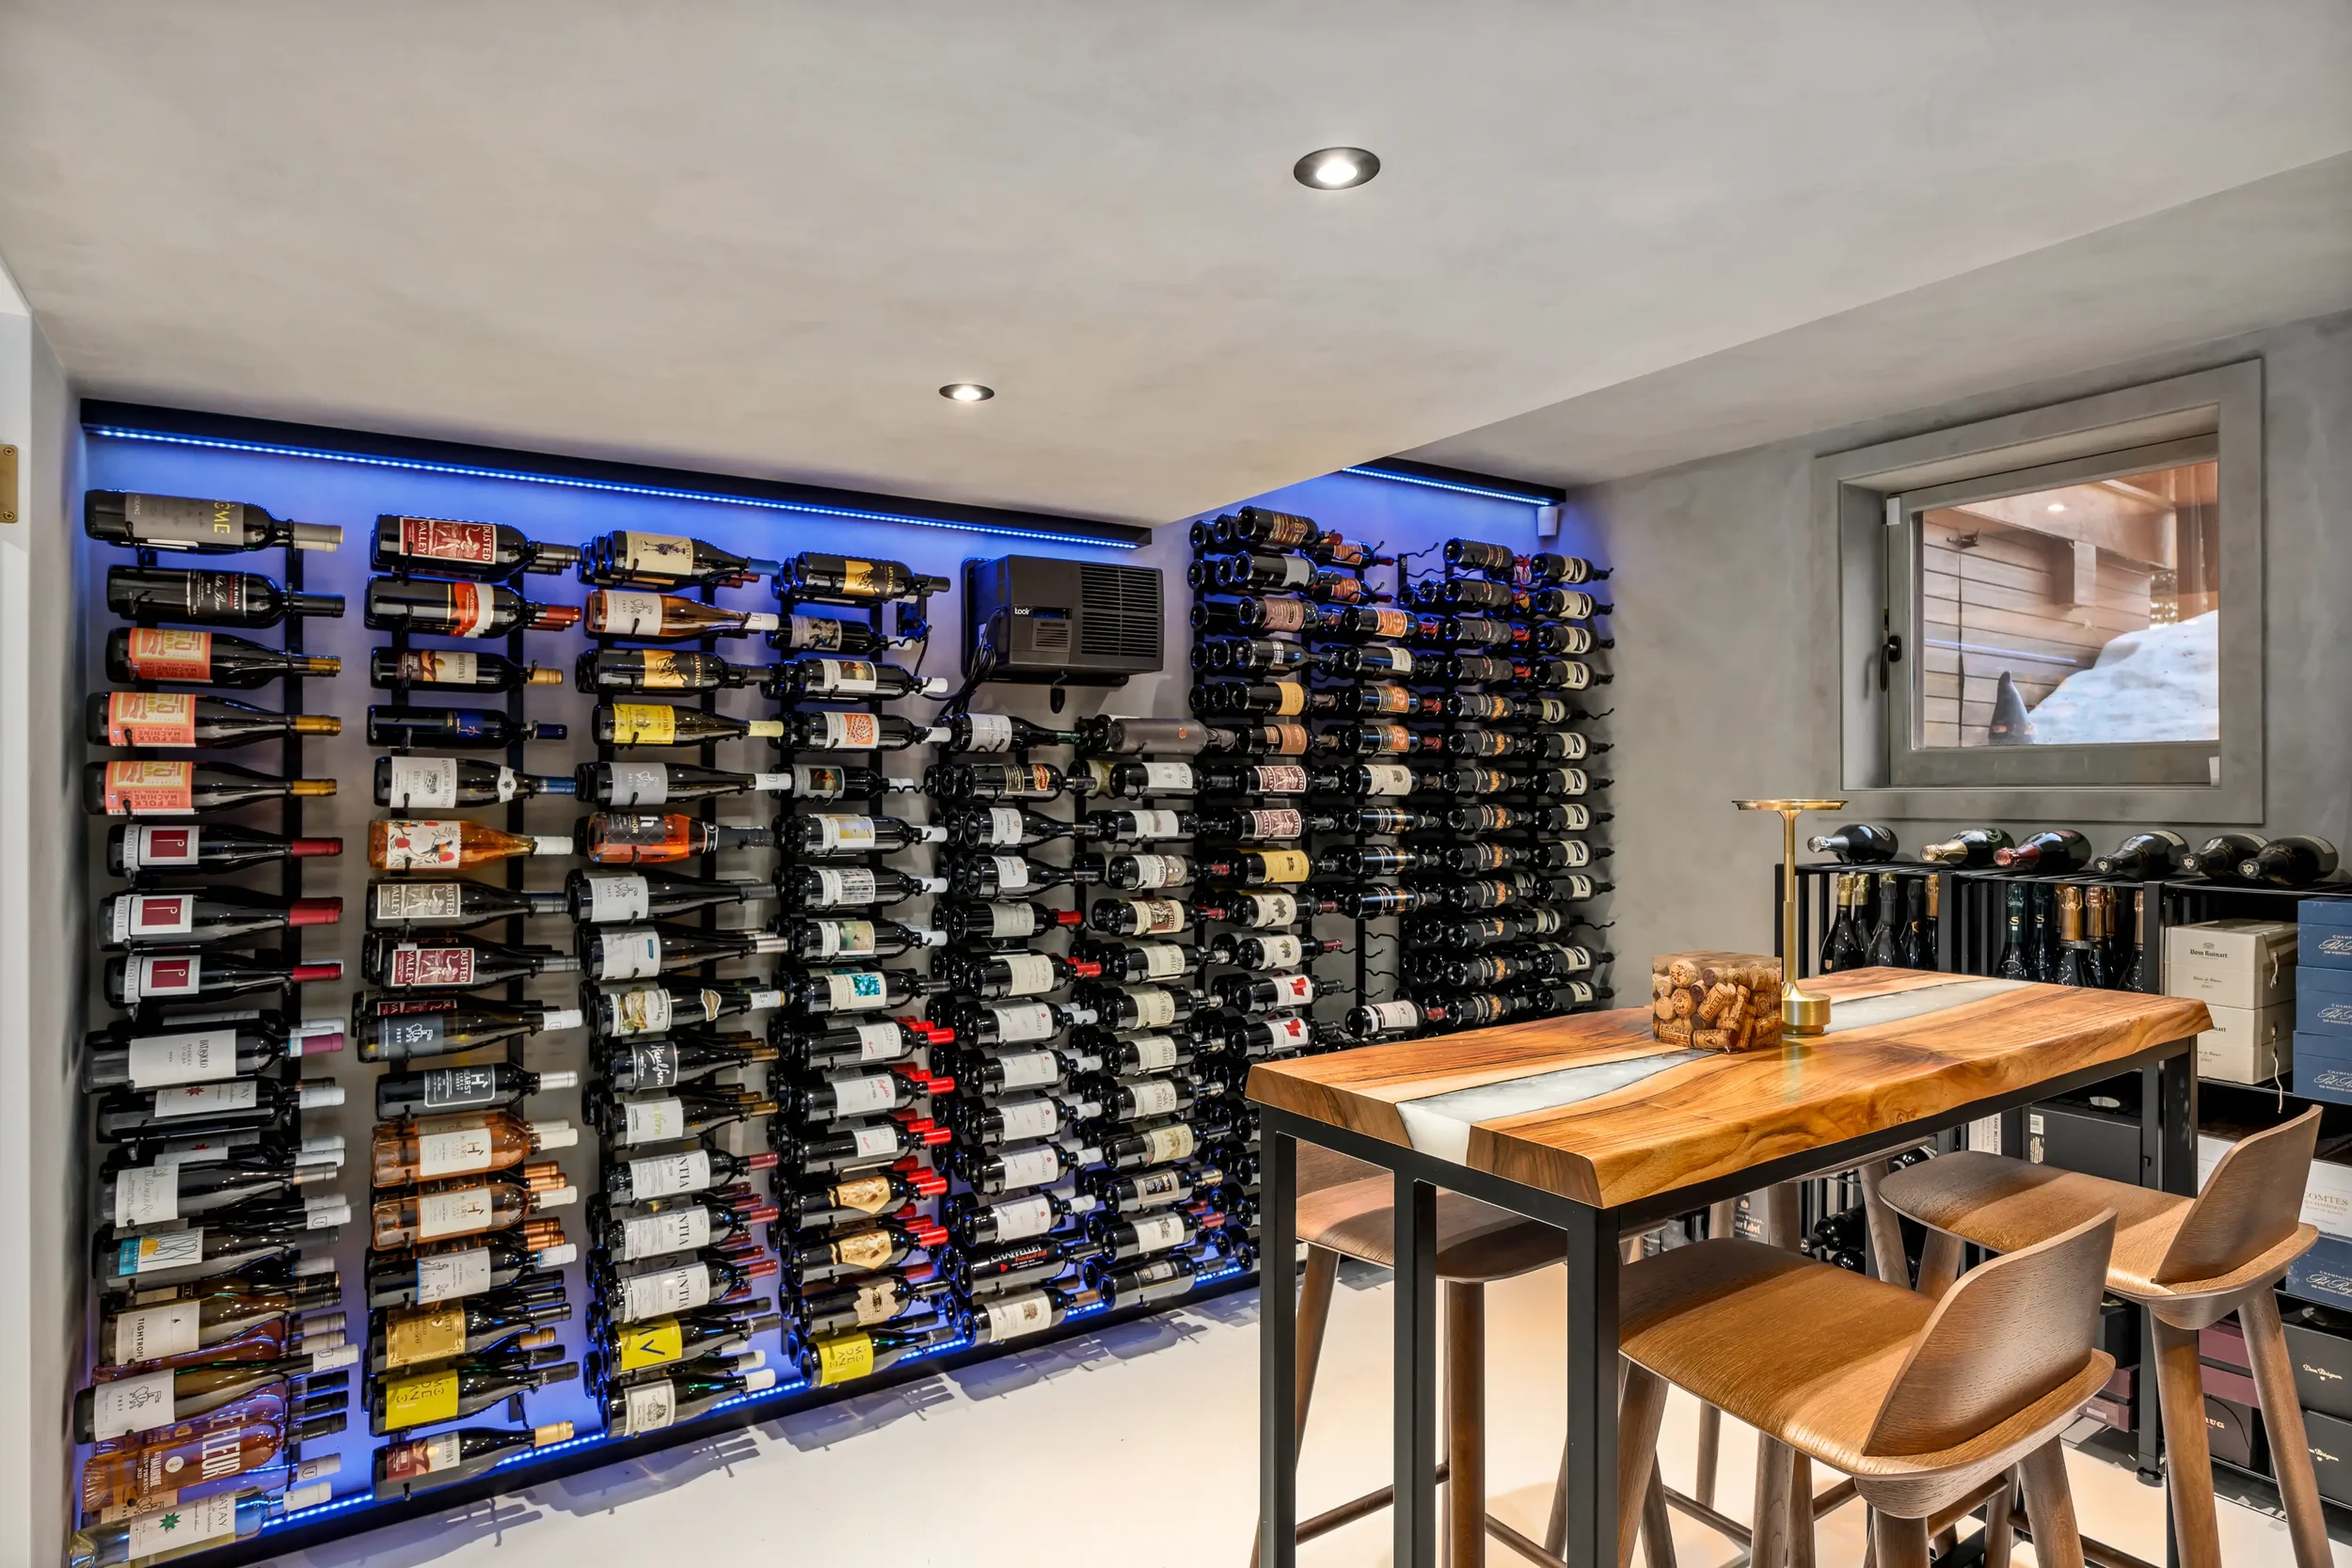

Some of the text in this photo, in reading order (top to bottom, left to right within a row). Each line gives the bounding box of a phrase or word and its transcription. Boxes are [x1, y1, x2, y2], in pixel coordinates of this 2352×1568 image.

[418, 521, 427, 554] VALLEY
[482, 526, 491, 561] DUSTED
[1264, 767, 1273, 789] VALLEY
[1295, 767, 1305, 789] DUSTED
[1262, 812, 1270, 835] VALLEY
[1291, 811, 1300, 835] DUSTED
[391, 885, 400, 916] VALLEY
[446, 885, 454, 915] DUSTED
[405, 951, 415, 984] VALLEY
[459, 950, 469, 982] DUSTED
[2205, 950, 2228, 958] Ruinart
[198, 1039, 209, 1069] BATASIOLO
[991, 1244, 1042, 1263] CHAPPELLET
[676, 1269, 690, 1308] PINTIA
[2318, 1285, 2337, 1293] WINSTON
[135, 1317, 145, 1357] TIGHTROPE
[2302, 1364, 2318, 1373] Dom
[201, 1426, 241, 1480] FLEUR
[218, 1494, 229, 1527] CATAY
